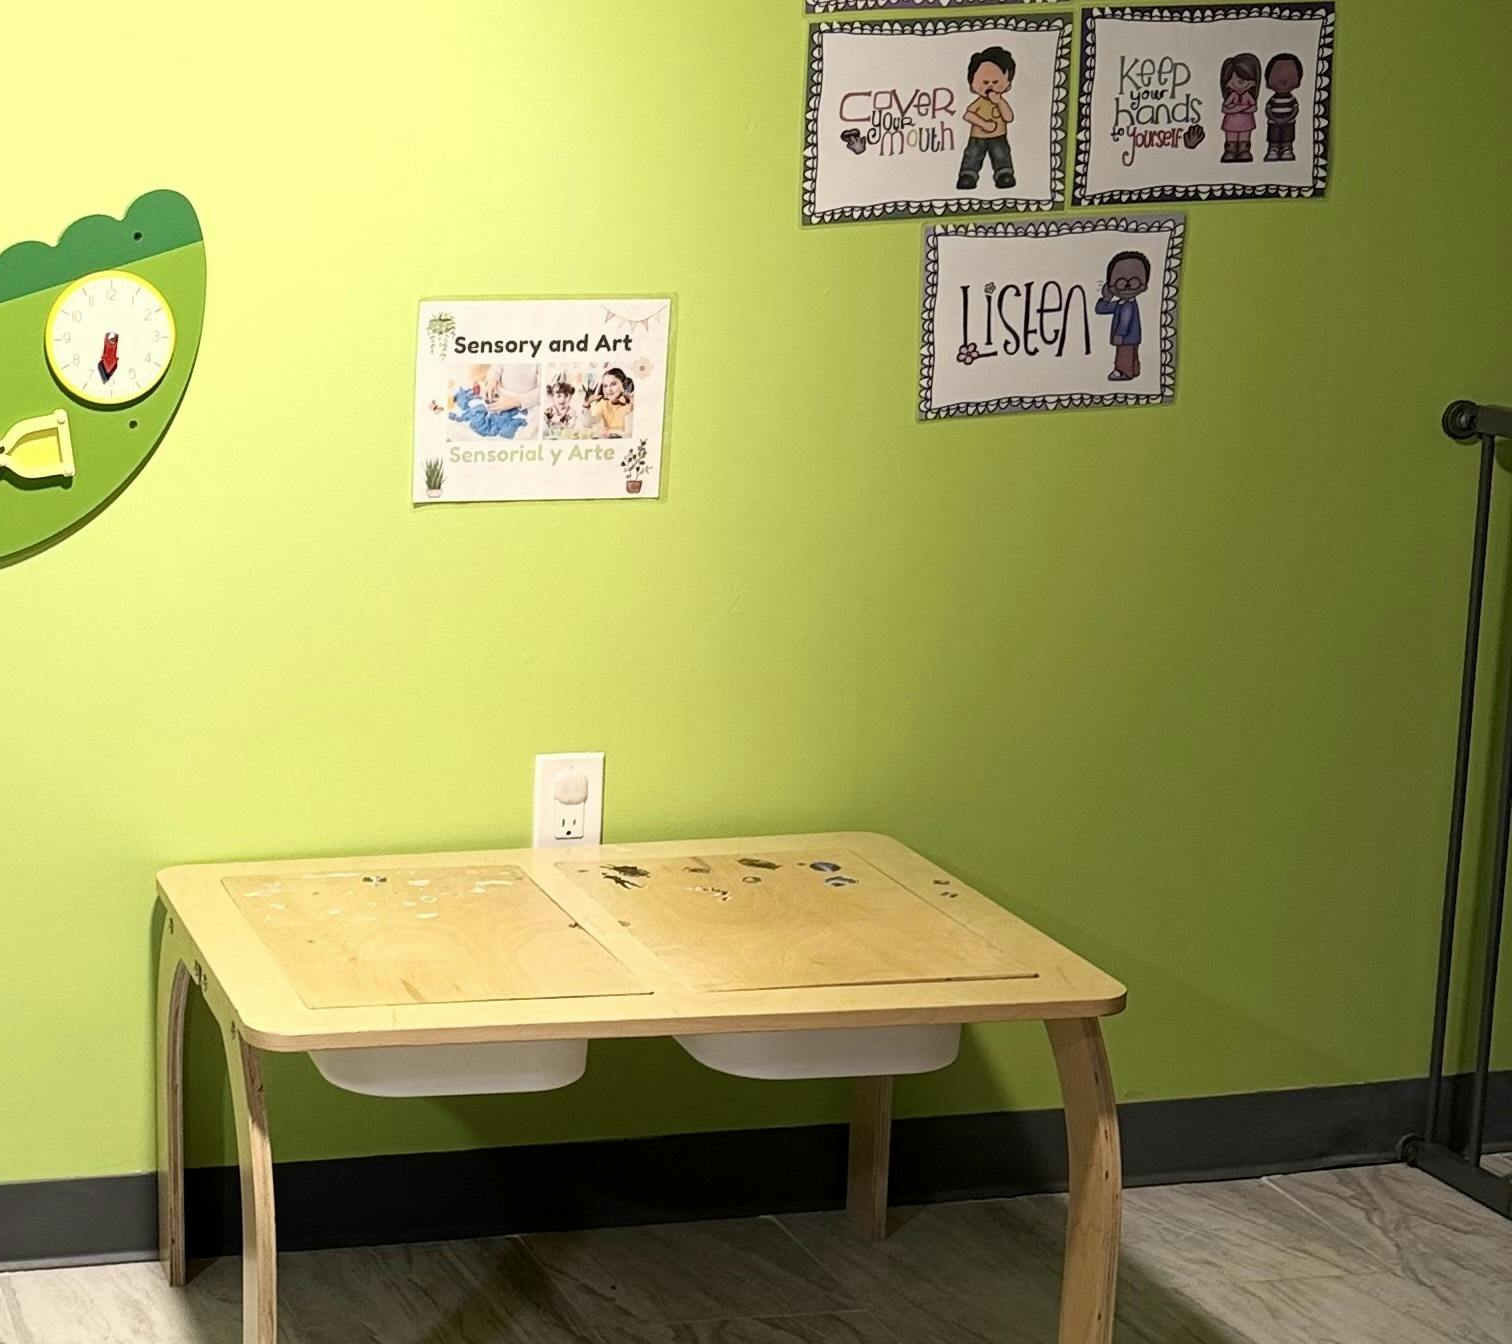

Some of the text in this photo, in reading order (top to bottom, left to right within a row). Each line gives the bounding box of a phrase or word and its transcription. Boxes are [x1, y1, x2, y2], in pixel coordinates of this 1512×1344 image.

[1130, 89, 1168, 110] your
[1114, 93, 1203, 126] hands
[1122, 125, 1185, 167] yourself
[88, 295, 95, 307] 11
[106, 289, 117, 301] 12
[71, 310, 82, 323] 10
[144, 309, 152, 321] 2
[958, 280, 1092, 358] Listen
[63, 331, 71, 344] 9
[153, 330, 160, 343] 3
[454, 334, 633, 358] Sensory and Art
[72, 353, 80, 366] 8
[144, 352, 151, 363] 4
[88, 369, 95, 380] 7
[128, 368, 136, 380] 5
[449, 444, 616, 466] Sensorial y Arte
